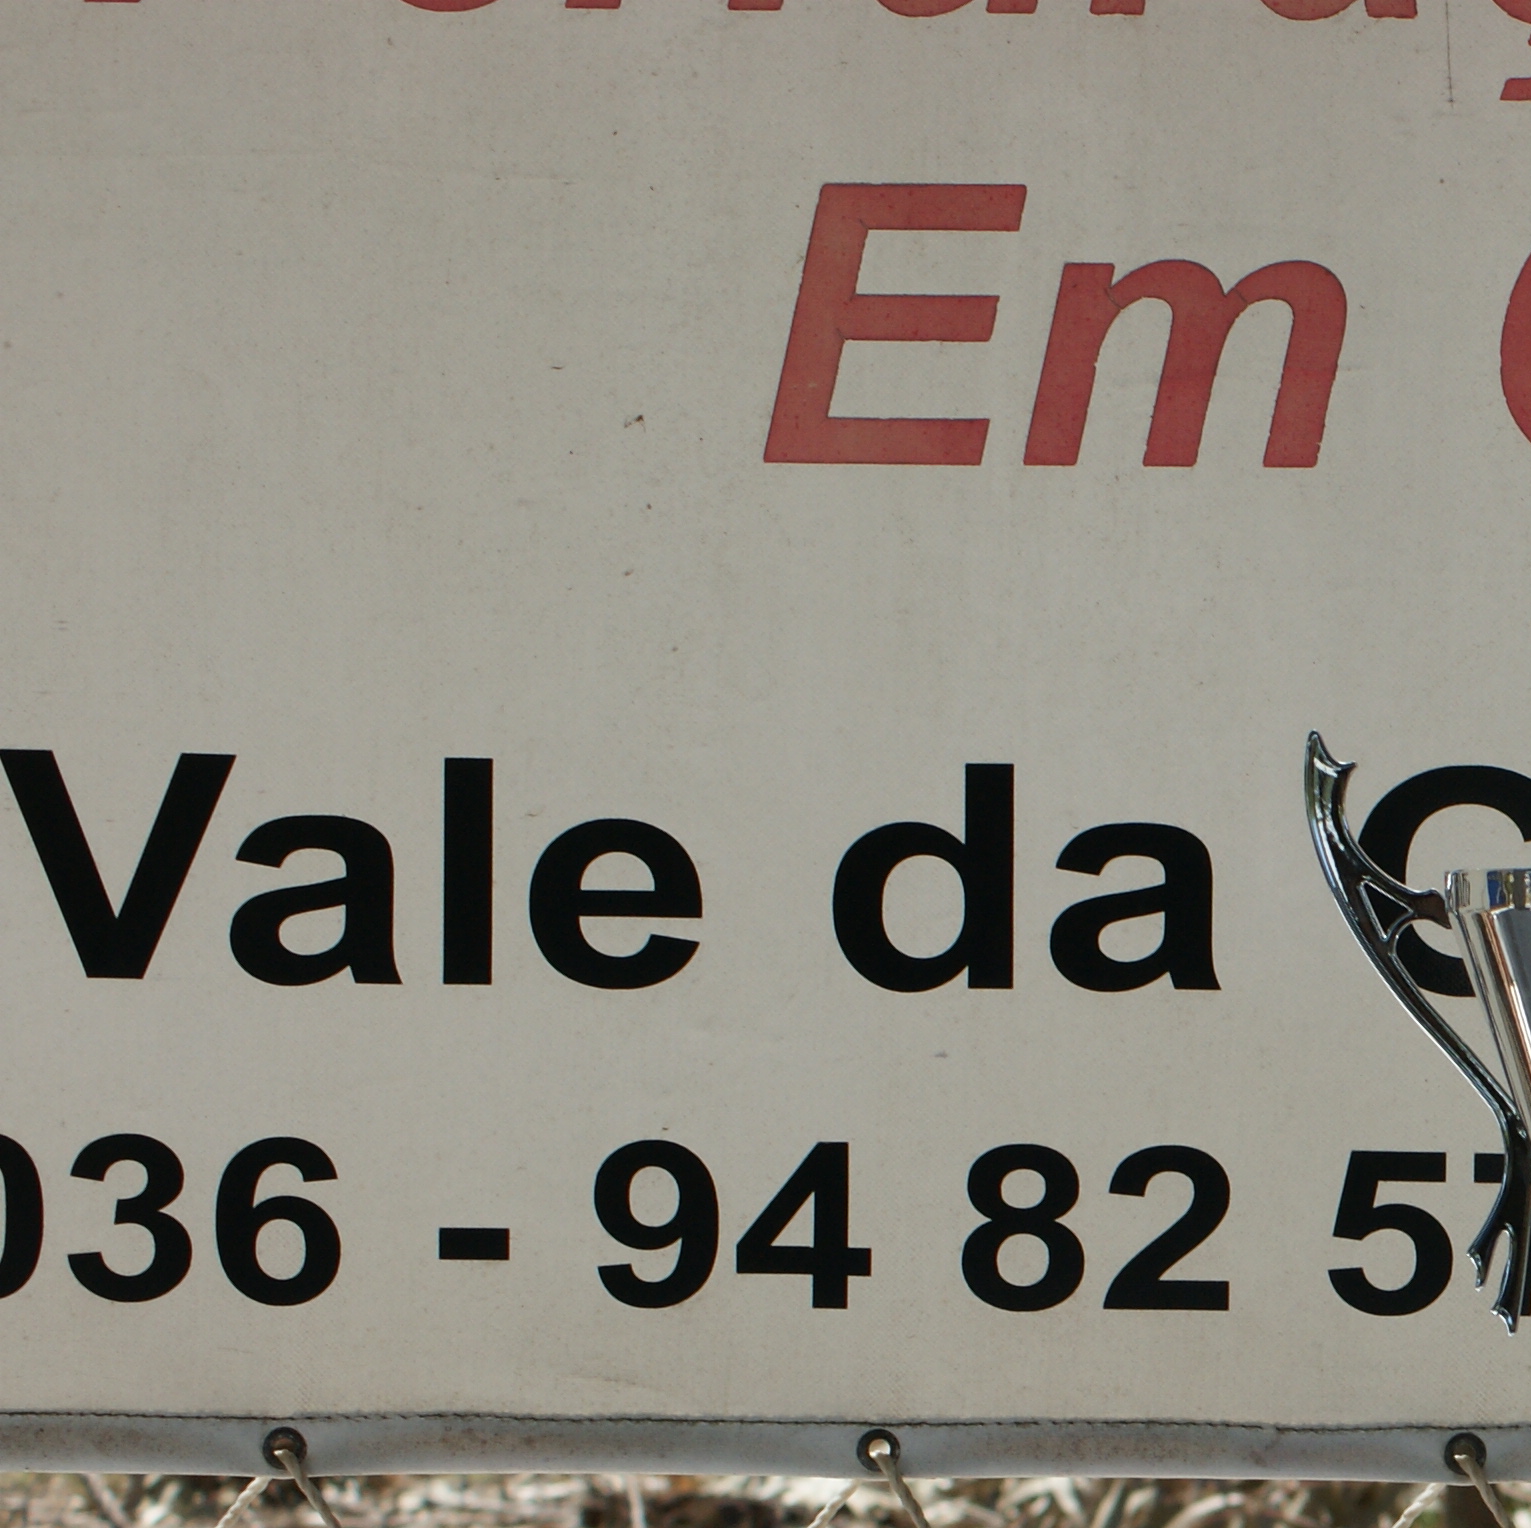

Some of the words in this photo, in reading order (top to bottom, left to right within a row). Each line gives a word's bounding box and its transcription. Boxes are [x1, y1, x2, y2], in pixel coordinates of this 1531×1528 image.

[763, 184, 1347, 469] Em
[0, 749, 703, 990] Vale
[832, 763, 1221, 993] da
[594, 1139, 872, 1310] 94
[961, 1143, 1230, 1312] 82
